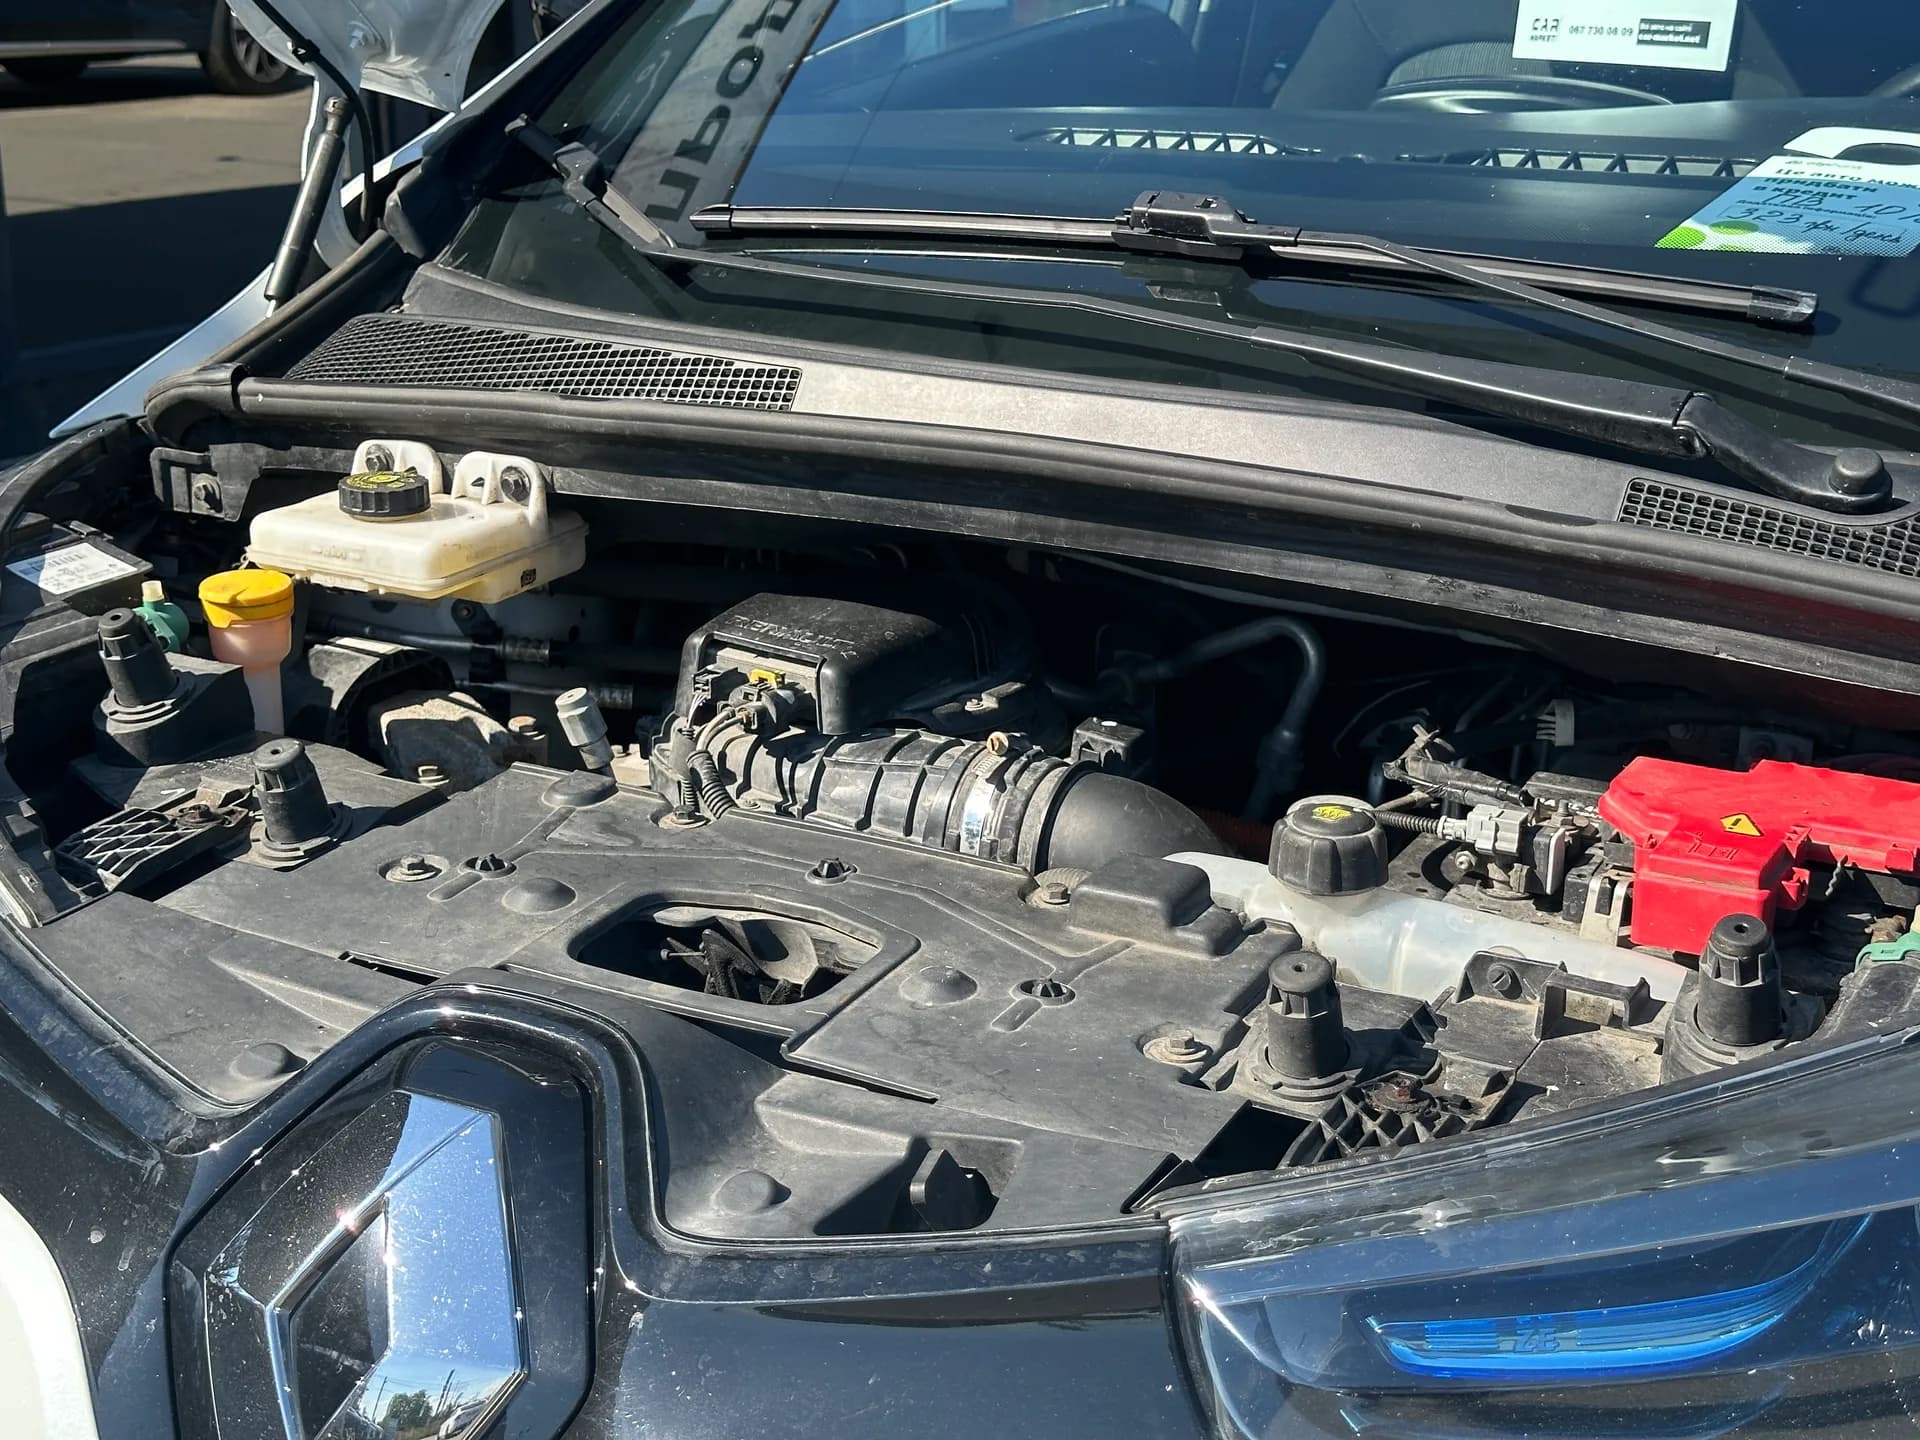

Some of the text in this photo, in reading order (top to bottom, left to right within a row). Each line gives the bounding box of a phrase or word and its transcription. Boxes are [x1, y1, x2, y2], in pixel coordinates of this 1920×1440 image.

[1532, 17, 1560, 32] CAR
[1775, 167, 1802, 176] Це
[1809, 171, 1863, 182] авто
[1764, 177, 1878, 193] придбати
[1770, 186, 1858, 200] кредит
[1726, 207, 1804, 224] 323
